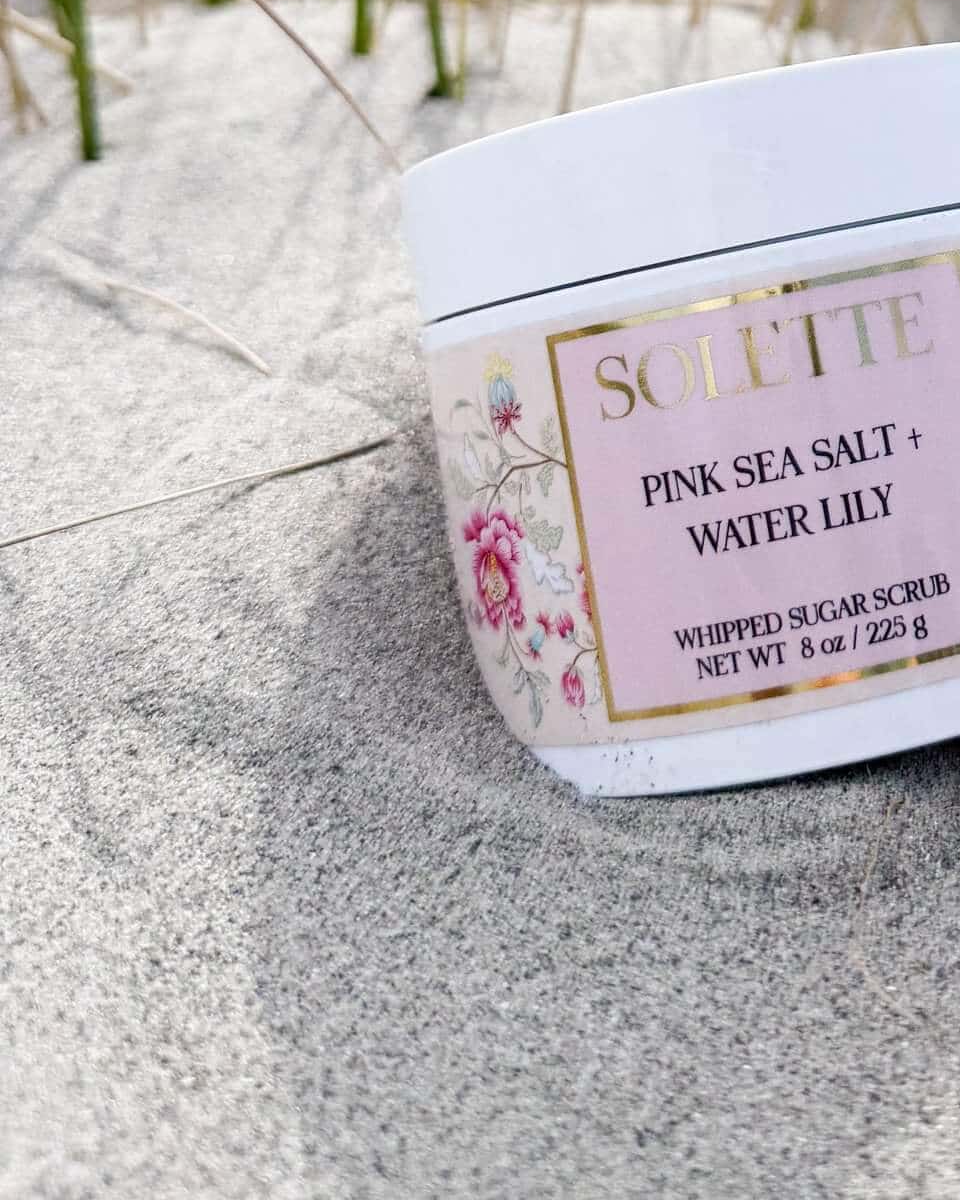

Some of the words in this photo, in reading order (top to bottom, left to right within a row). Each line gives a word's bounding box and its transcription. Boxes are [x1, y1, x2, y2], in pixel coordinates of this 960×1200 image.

[595, 291, 935, 422] SOLETTE
[641, 461, 726, 507] PINK
[733, 446, 804, 488] SEA
[811, 423, 896, 472] SALT
[907, 428, 922, 450] +
[686, 504, 815, 557] WATER
[819, 483, 893, 531] LILY
[673, 611, 783, 651] WHIPPED
[788, 593, 870, 630] SUGAR
[874, 572, 951, 610] SCRUB
[696, 650, 741, 680] NET
[747, 642, 787, 670] WT
[801, 637, 814, 659] 8
[821, 634, 846, 655] oz
[852, 624, 859, 650] /
[866, 615, 907, 645] 225
[913, 614, 929, 640] g
